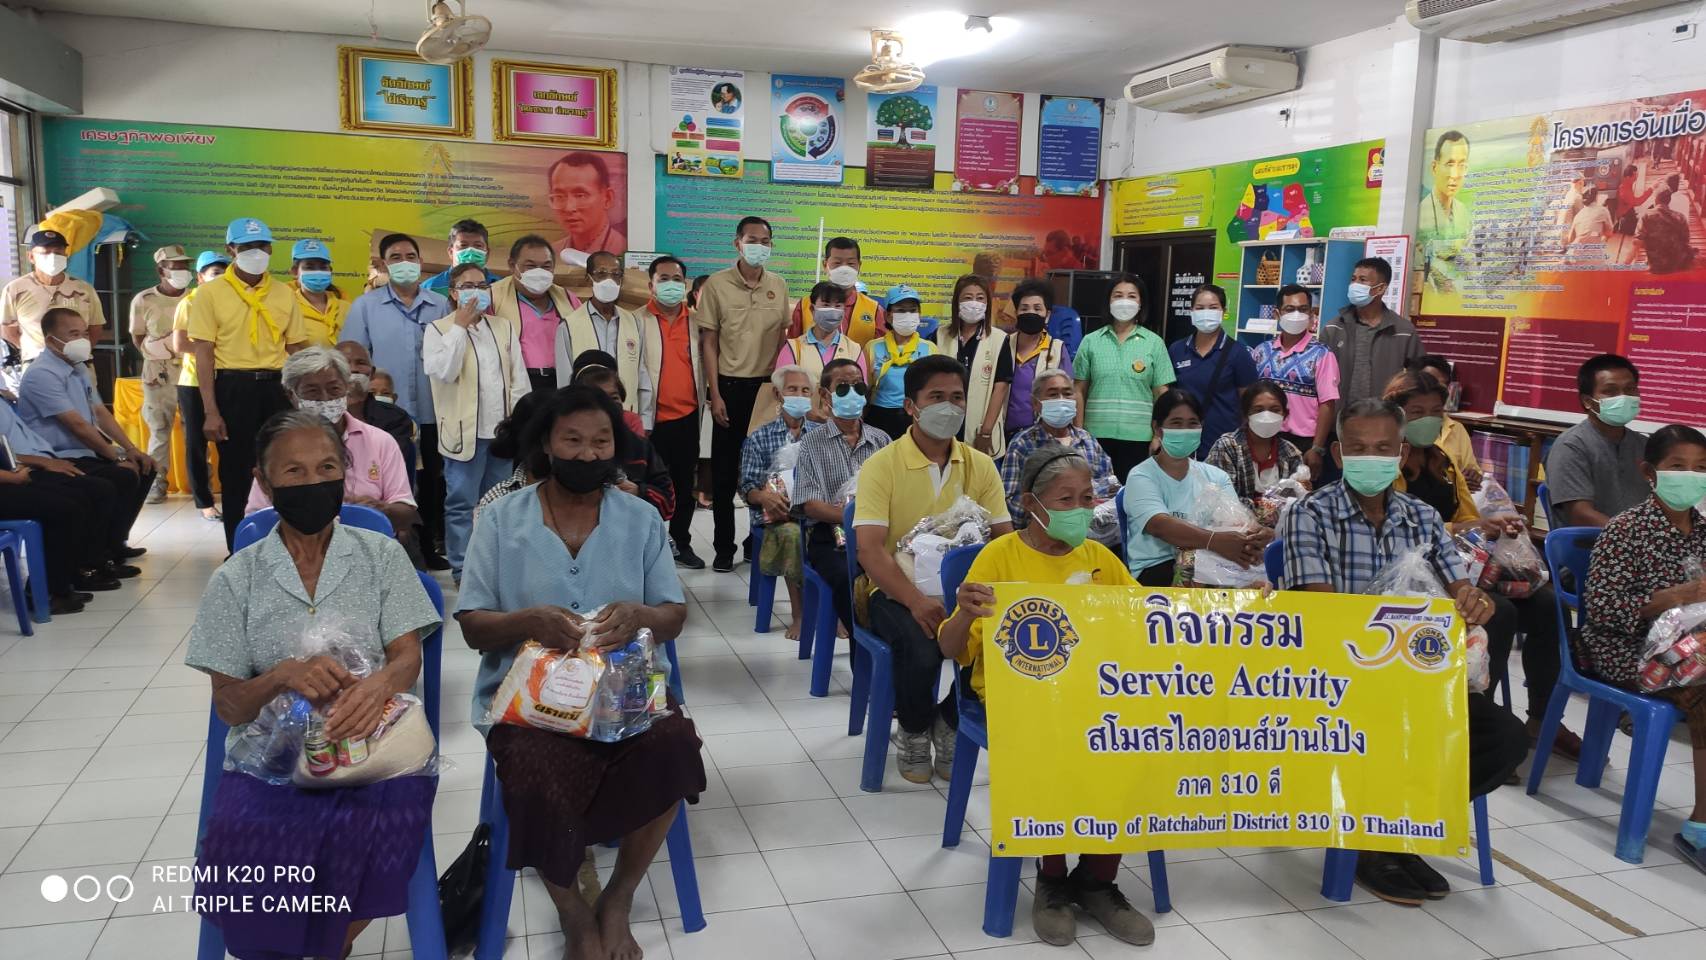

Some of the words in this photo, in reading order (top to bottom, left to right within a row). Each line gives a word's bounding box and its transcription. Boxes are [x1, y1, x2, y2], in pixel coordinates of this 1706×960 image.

[80, 129, 217, 146] เศรษฐกิจพอเพียง
[1552, 100, 1706, 149] โครงการอันเนื่อ
[1012, 601, 1059, 619] LIONS
[1145, 593, 1304, 648] กิจกรรม
[1028, 623, 1049, 650] L
[1014, 657, 1062, 673] INTERNATIONAL
[1098, 663, 1215, 697] Service
[1229, 666, 1350, 708] Activity
[1087, 713, 1366, 754] สโมสรไลออนส์บ้านโป่ง
[1177, 776, 1212, 796] ภาค
[1220, 773, 1259, 795] 310
[1268, 767, 1282, 795] ดี
[1013, 819, 1064, 837] Lions
[1074, 817, 1118, 840] Clup
[1126, 816, 1142, 835] of
[1148, 815, 1226, 833] Ratchaburi
[1232, 813, 1289, 830] District
[1297, 814, 1330, 830] 310
[1341, 815, 1356, 832] D
[1363, 816, 1445, 838] Thailand
